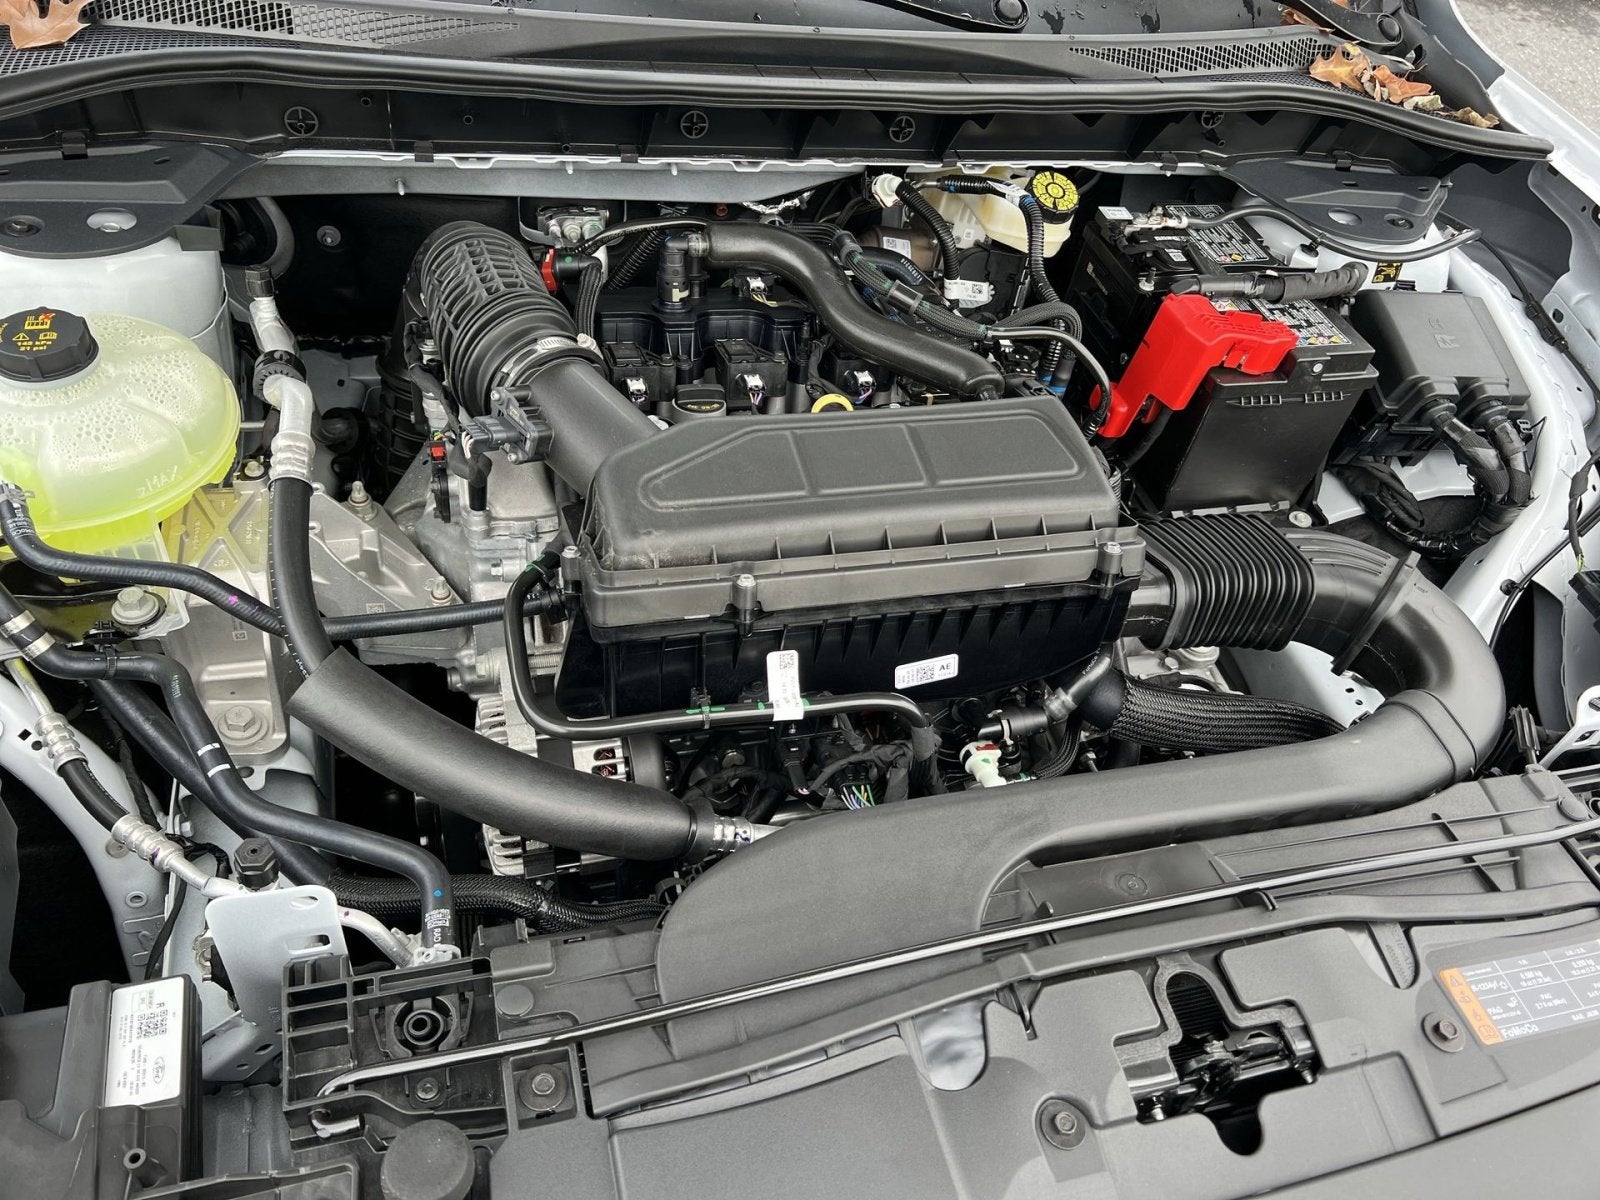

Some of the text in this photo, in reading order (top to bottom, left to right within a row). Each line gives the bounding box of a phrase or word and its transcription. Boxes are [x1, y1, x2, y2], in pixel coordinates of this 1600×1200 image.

[939, 662, 952, 671] AE
[433, 928, 441, 942] RAD
[1500, 1024, 1539, 1038] FoMoCo
